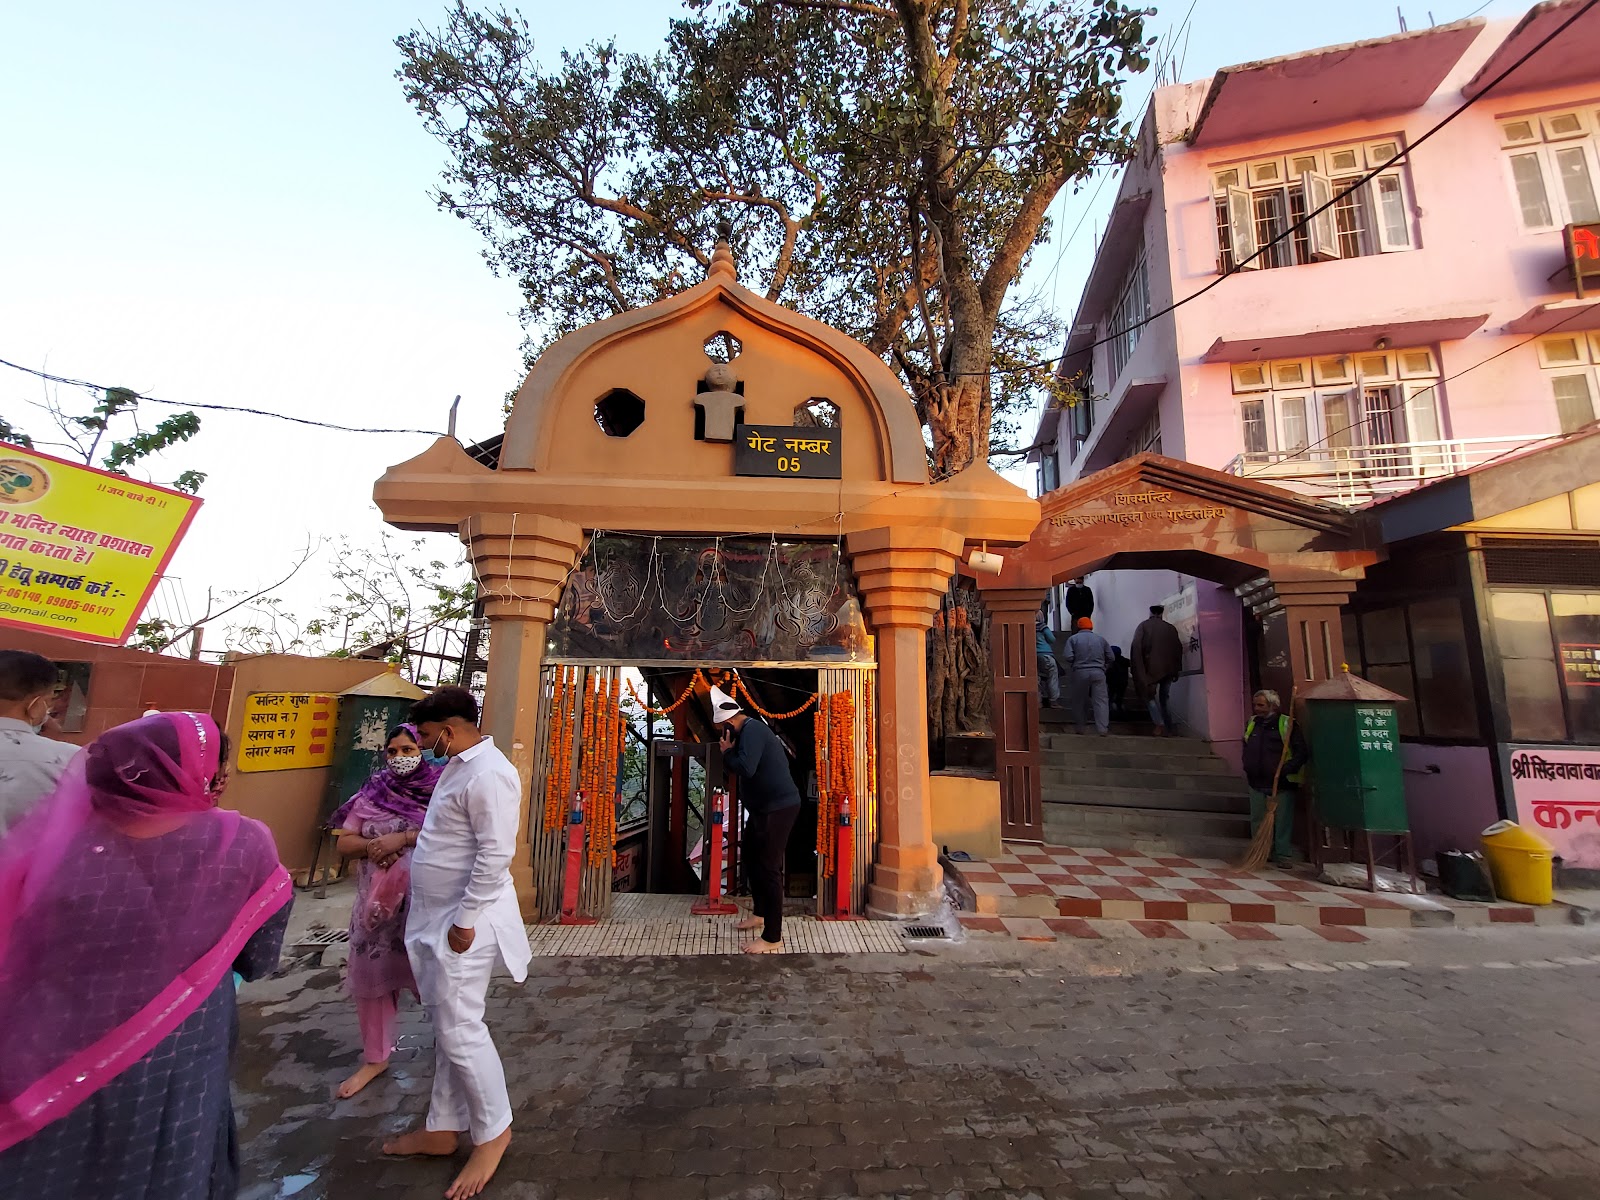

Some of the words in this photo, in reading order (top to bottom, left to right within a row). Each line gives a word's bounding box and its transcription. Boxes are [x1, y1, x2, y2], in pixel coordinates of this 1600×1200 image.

[747, 431, 777, 453] गेट
[783, 438, 832, 455] नम्बर
[777, 456, 801, 472] 05
[10, 513, 58, 535] मन्दिर
[58, 525, 98, 544] न्यास
[97, 534, 154, 558] प्रशासन
[29, 540, 73, 561] करता
[35, 570, 86, 591] सम्पर्क
[255, 694, 285, 707] मन्दिर
[290, 695, 310, 708] गुफा
[251, 713, 278, 724] सराय
[292, 712, 299, 722] 7
[248, 730, 275, 742] सराय
[245, 745, 272, 759] लंगर
[273, 745, 296, 756] भवन
